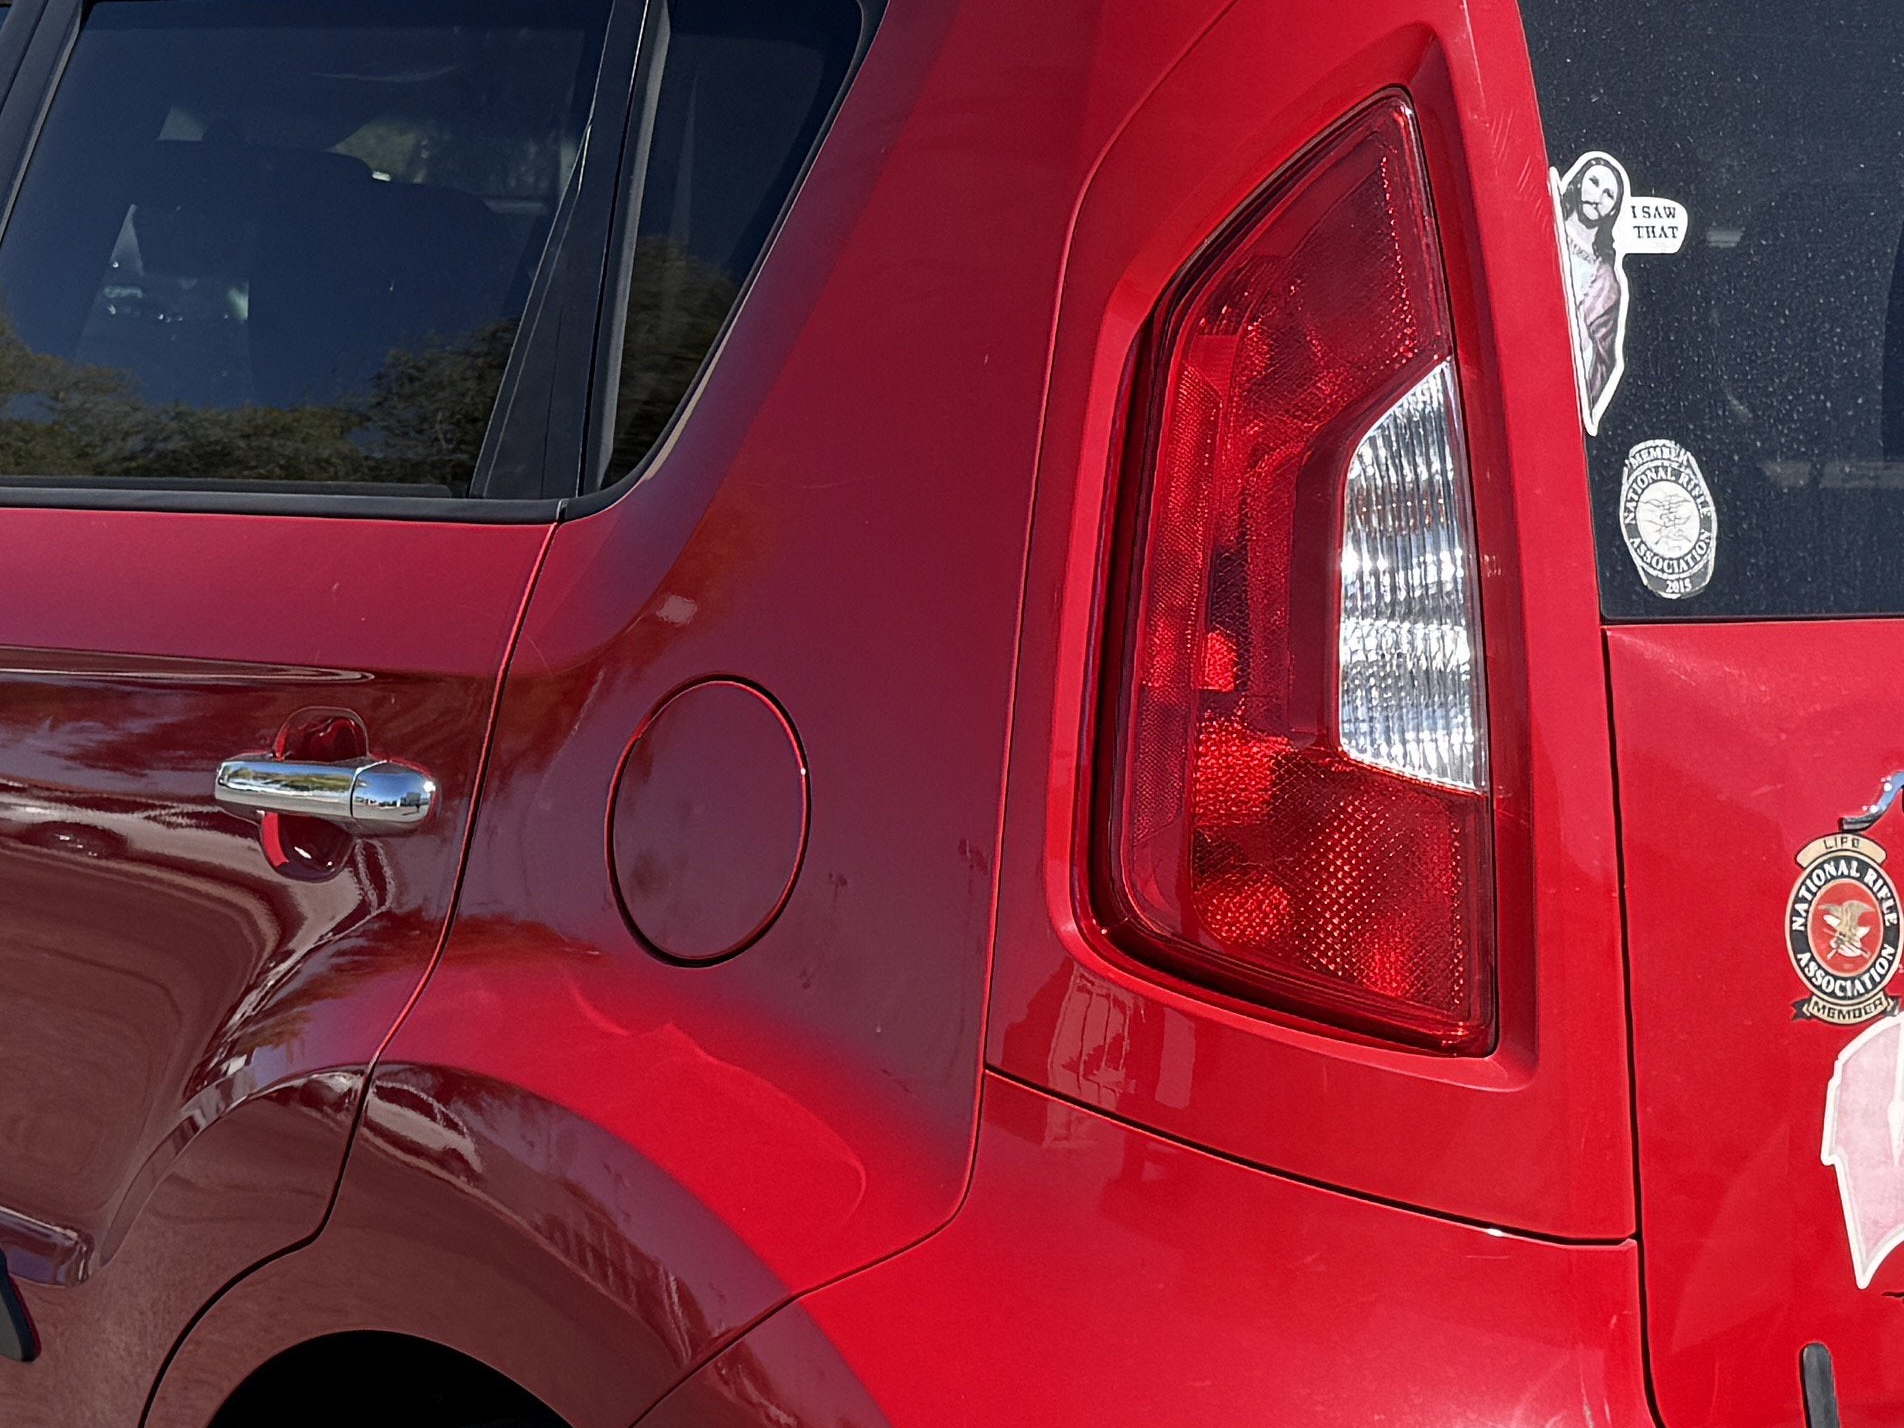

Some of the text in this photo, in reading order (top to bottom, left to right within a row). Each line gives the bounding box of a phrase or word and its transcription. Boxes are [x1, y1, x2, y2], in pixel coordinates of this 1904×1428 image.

[1630, 204, 1676, 219] I SAW
[1632, 224, 1679, 239] THAT
[1623, 467, 1712, 525] NATIONAL RIFLE
[1629, 528, 1712, 574] ASSOCIATION
[1823, 835, 1861, 850] LIFE
[1791, 859, 1898, 932] NATIONAL RIFLE
[1796, 943, 1895, 998] ASSOCIATION
[1811, 995, 1884, 1022] MEMBER
